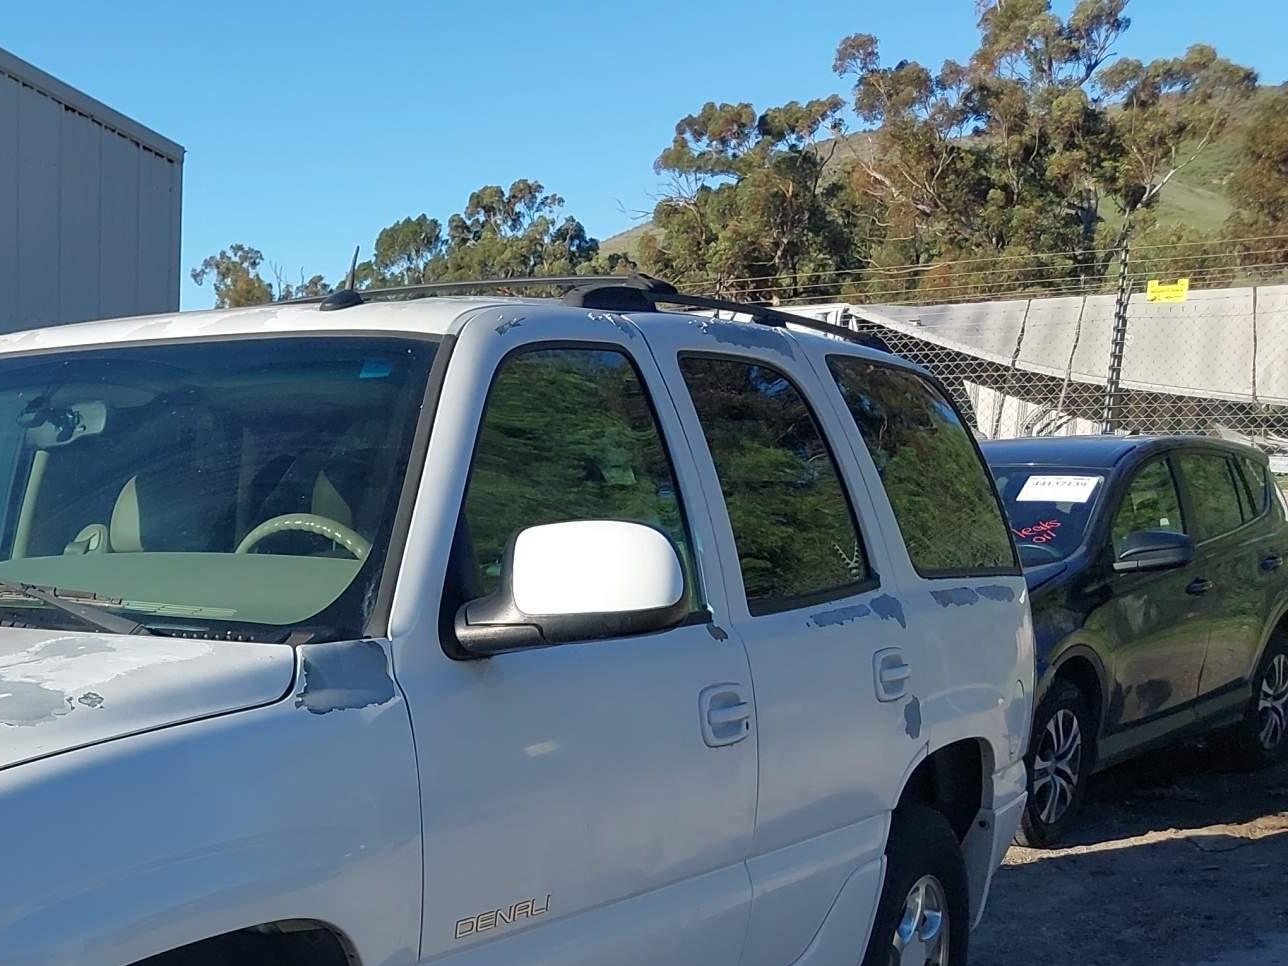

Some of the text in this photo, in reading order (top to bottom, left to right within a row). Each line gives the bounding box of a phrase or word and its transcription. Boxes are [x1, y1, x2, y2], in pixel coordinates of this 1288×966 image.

[1011, 520, 1061, 538] leaks
[1032, 530, 1056, 543] oil
[455, 894, 551, 939] DENALI
